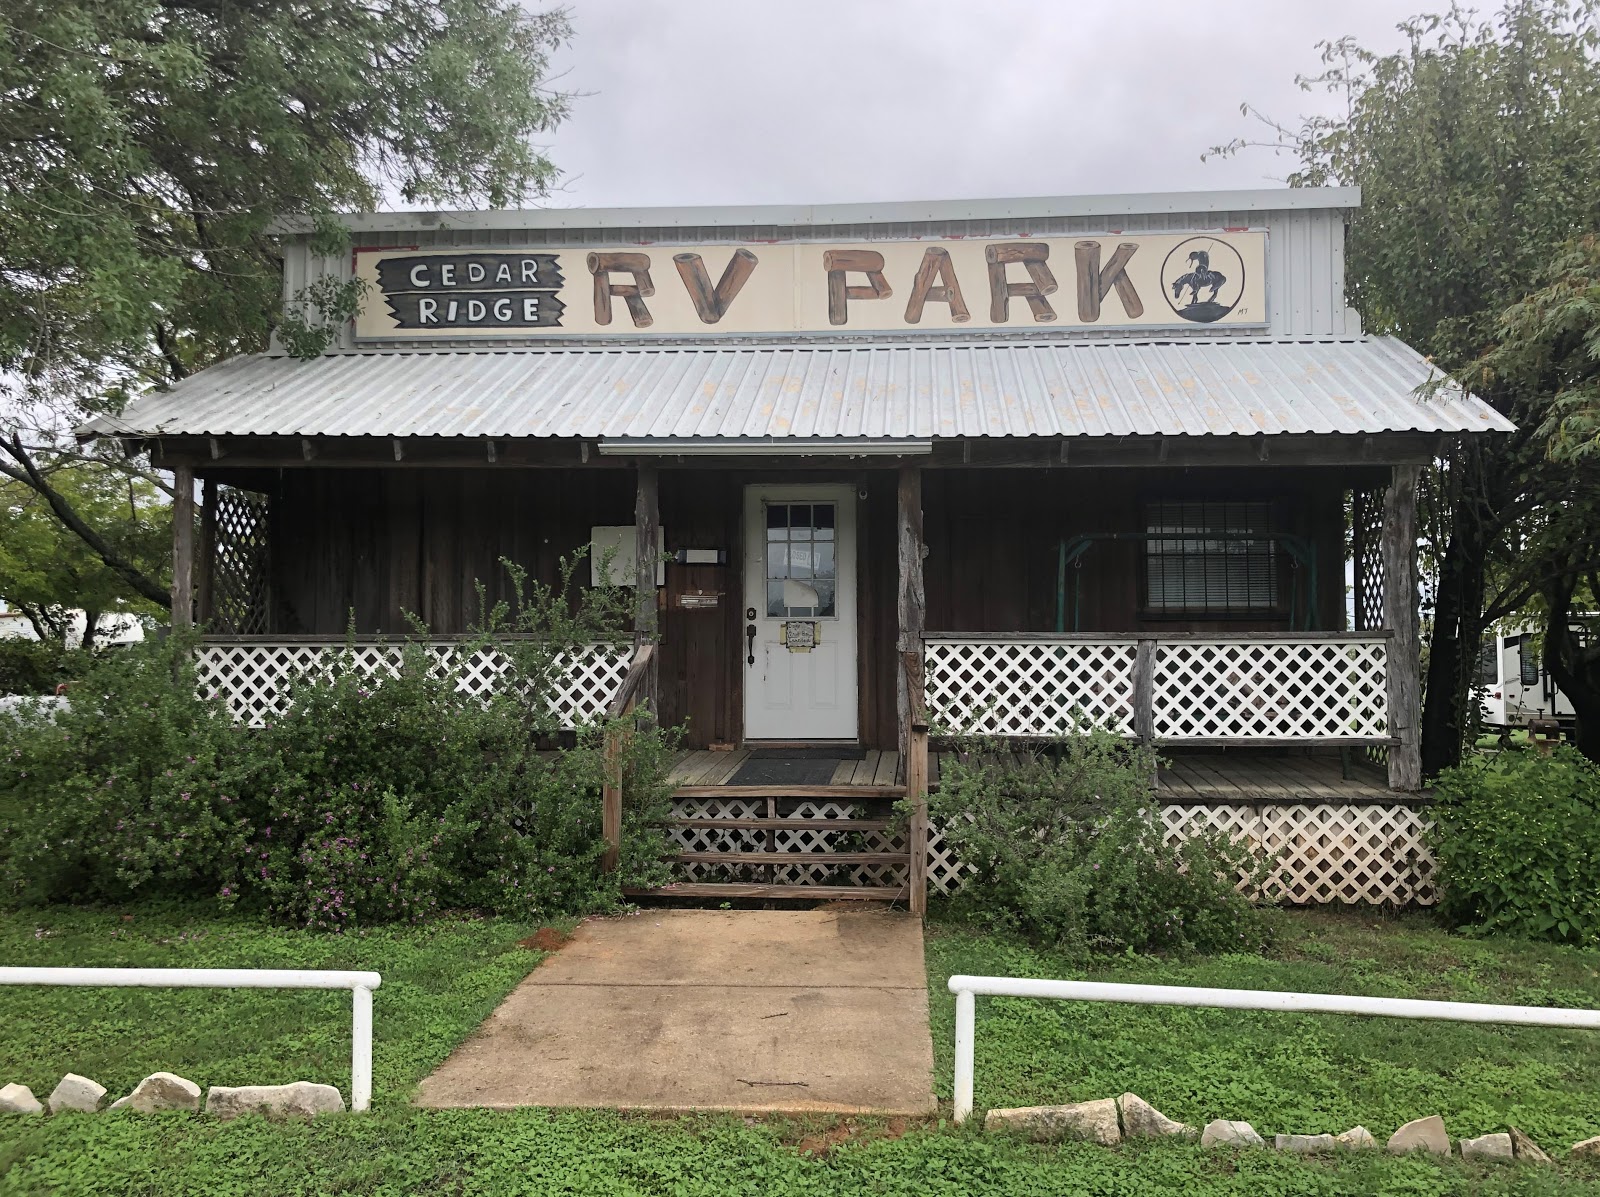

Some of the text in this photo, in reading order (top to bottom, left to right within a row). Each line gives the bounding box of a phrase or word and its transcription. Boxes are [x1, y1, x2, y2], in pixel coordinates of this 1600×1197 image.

[409, 259, 539, 288] CEDAR
[586, 240, 1145, 328] RV PARK
[418, 298, 540, 324] RIDGE
